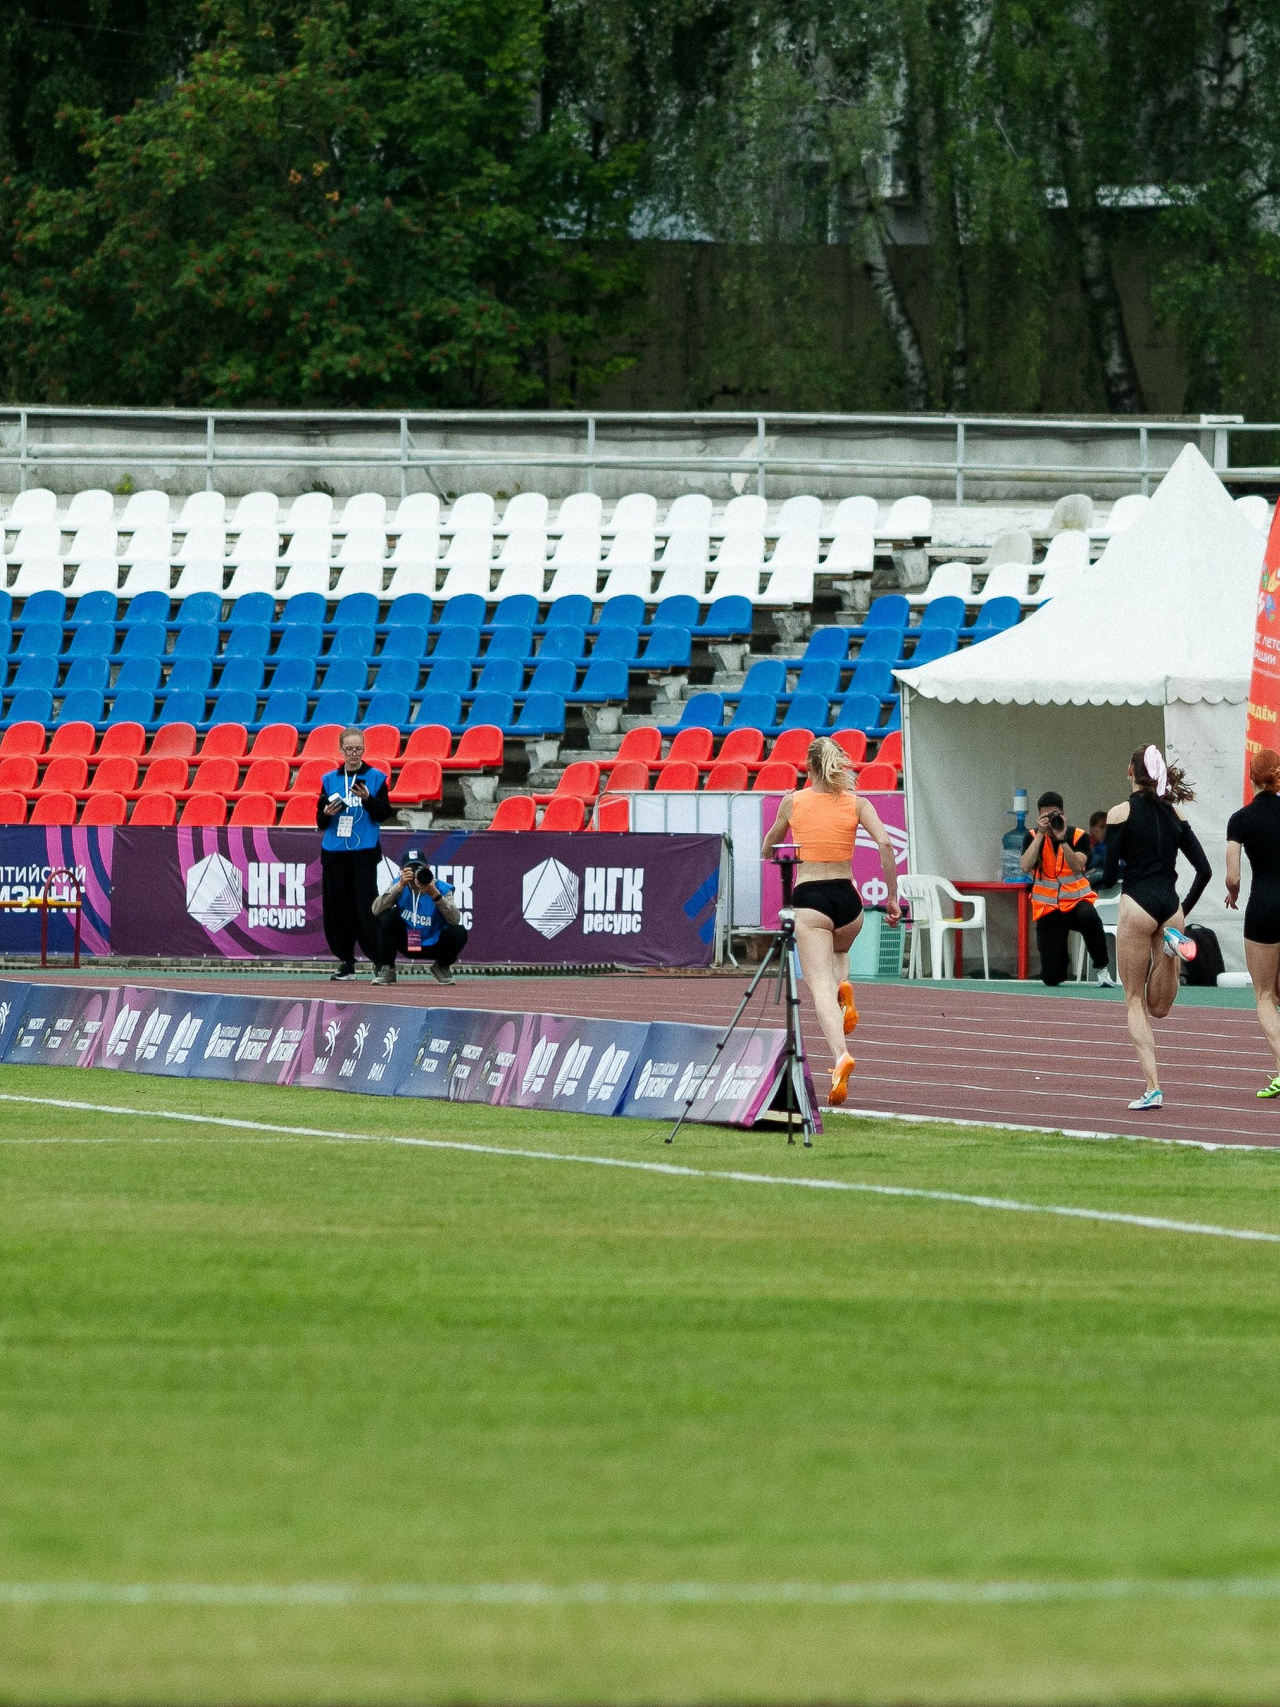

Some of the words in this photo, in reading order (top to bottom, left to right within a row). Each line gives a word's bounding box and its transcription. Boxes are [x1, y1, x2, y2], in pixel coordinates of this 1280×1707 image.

[0, 864, 86, 883] ТИЙСКИЙ
[248, 862, 306, 906] НГК
[584, 867, 644, 911] НГК
[248, 907, 306, 929] ресурс
[583, 913, 642, 935] ресурс
